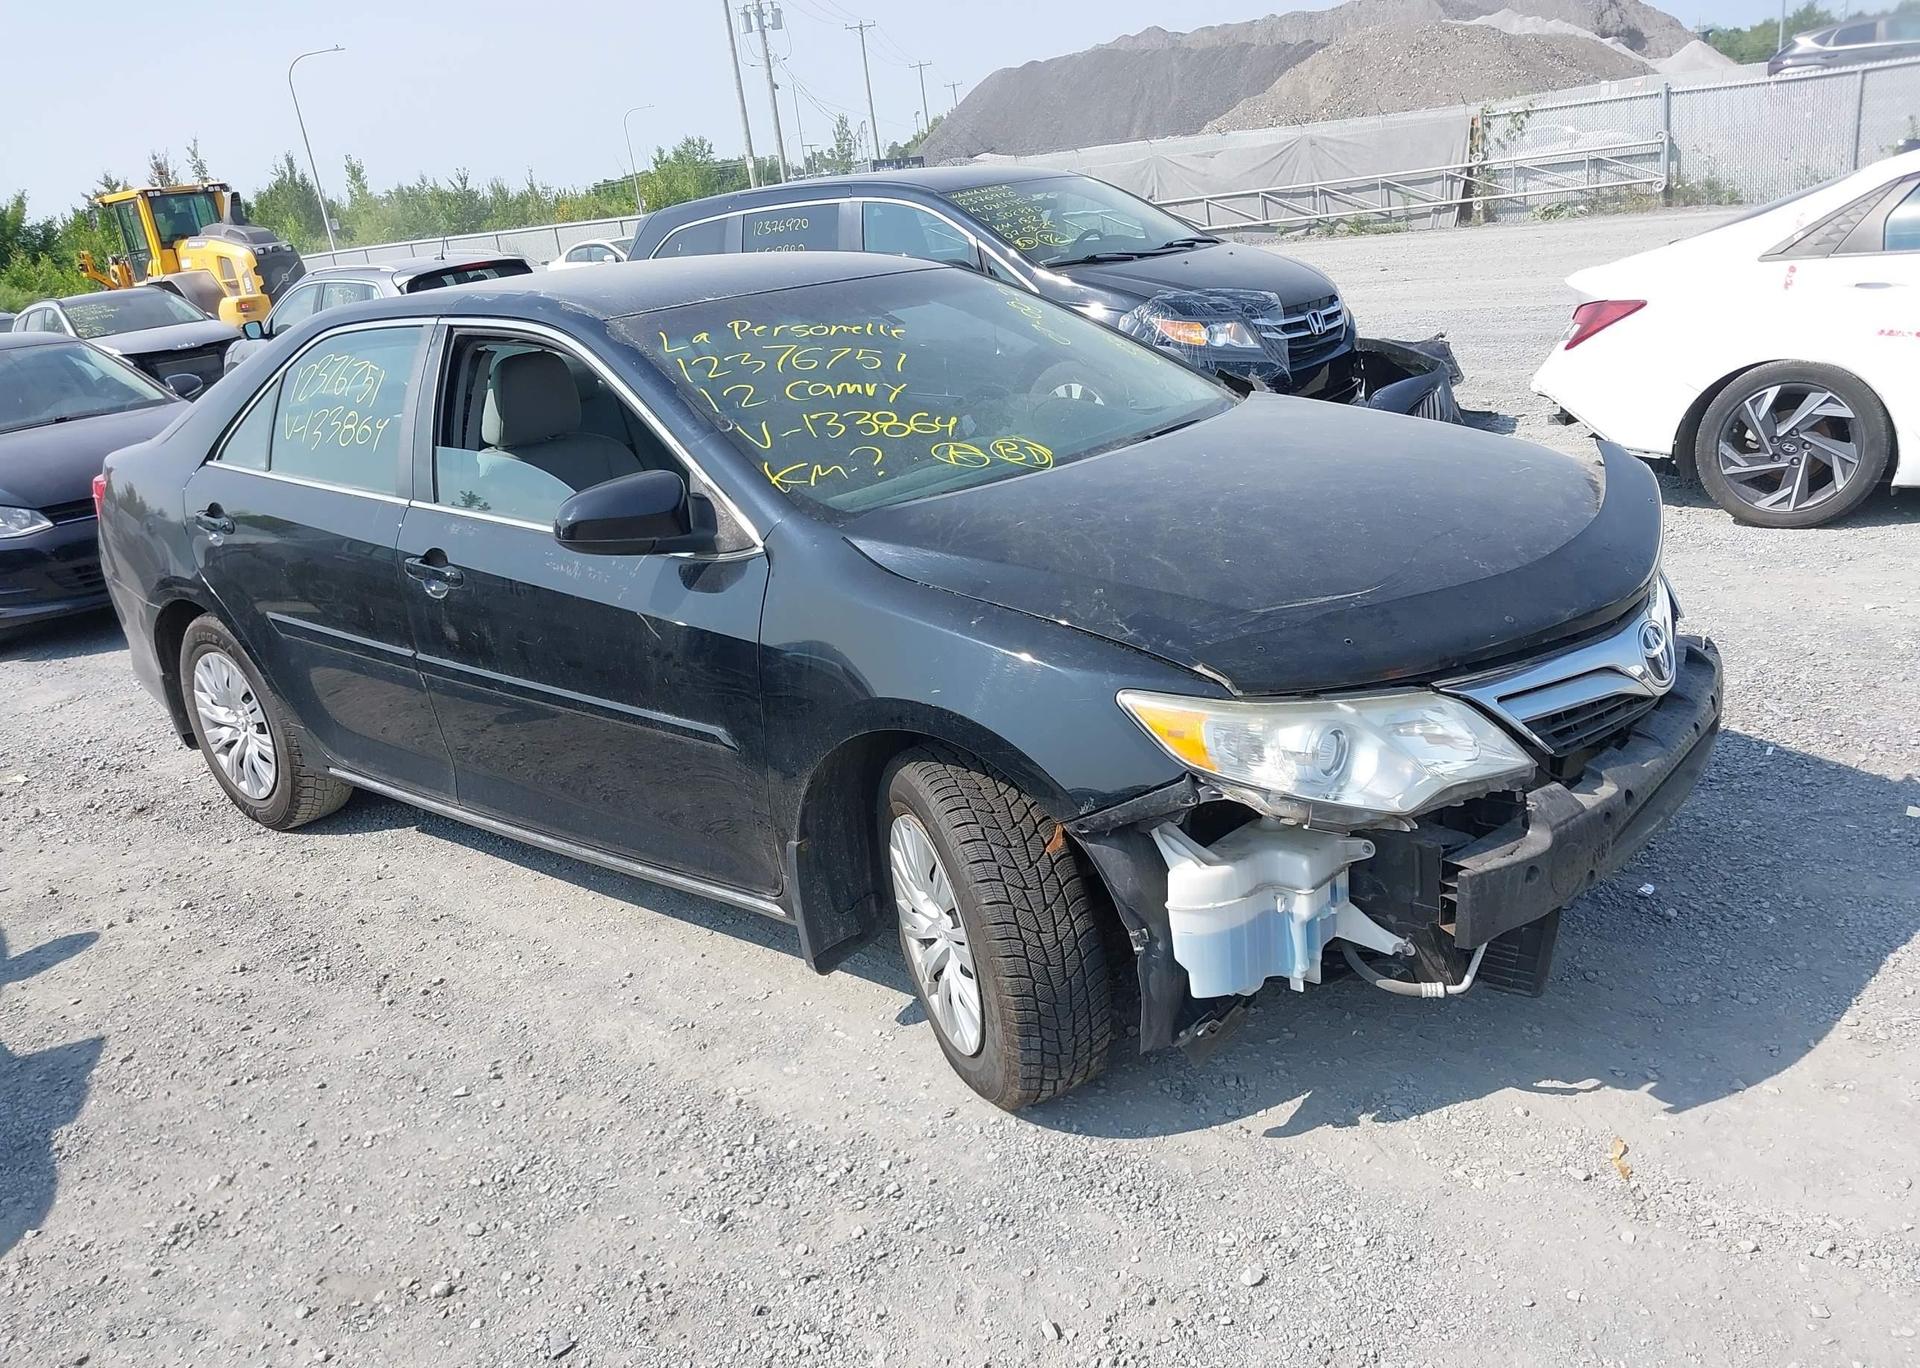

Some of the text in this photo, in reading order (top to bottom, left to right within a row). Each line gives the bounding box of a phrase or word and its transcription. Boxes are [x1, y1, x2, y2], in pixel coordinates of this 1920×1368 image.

[753, 217, 809, 236] 12376920
[658, 331, 711, 353] La
[290, 353, 386, 408] 12376751
[676, 344, 906, 383] 12376751
[699, 384, 769, 413] 12
[285, 405, 391, 453] V-133864
[736, 410, 958, 450] V-133864
